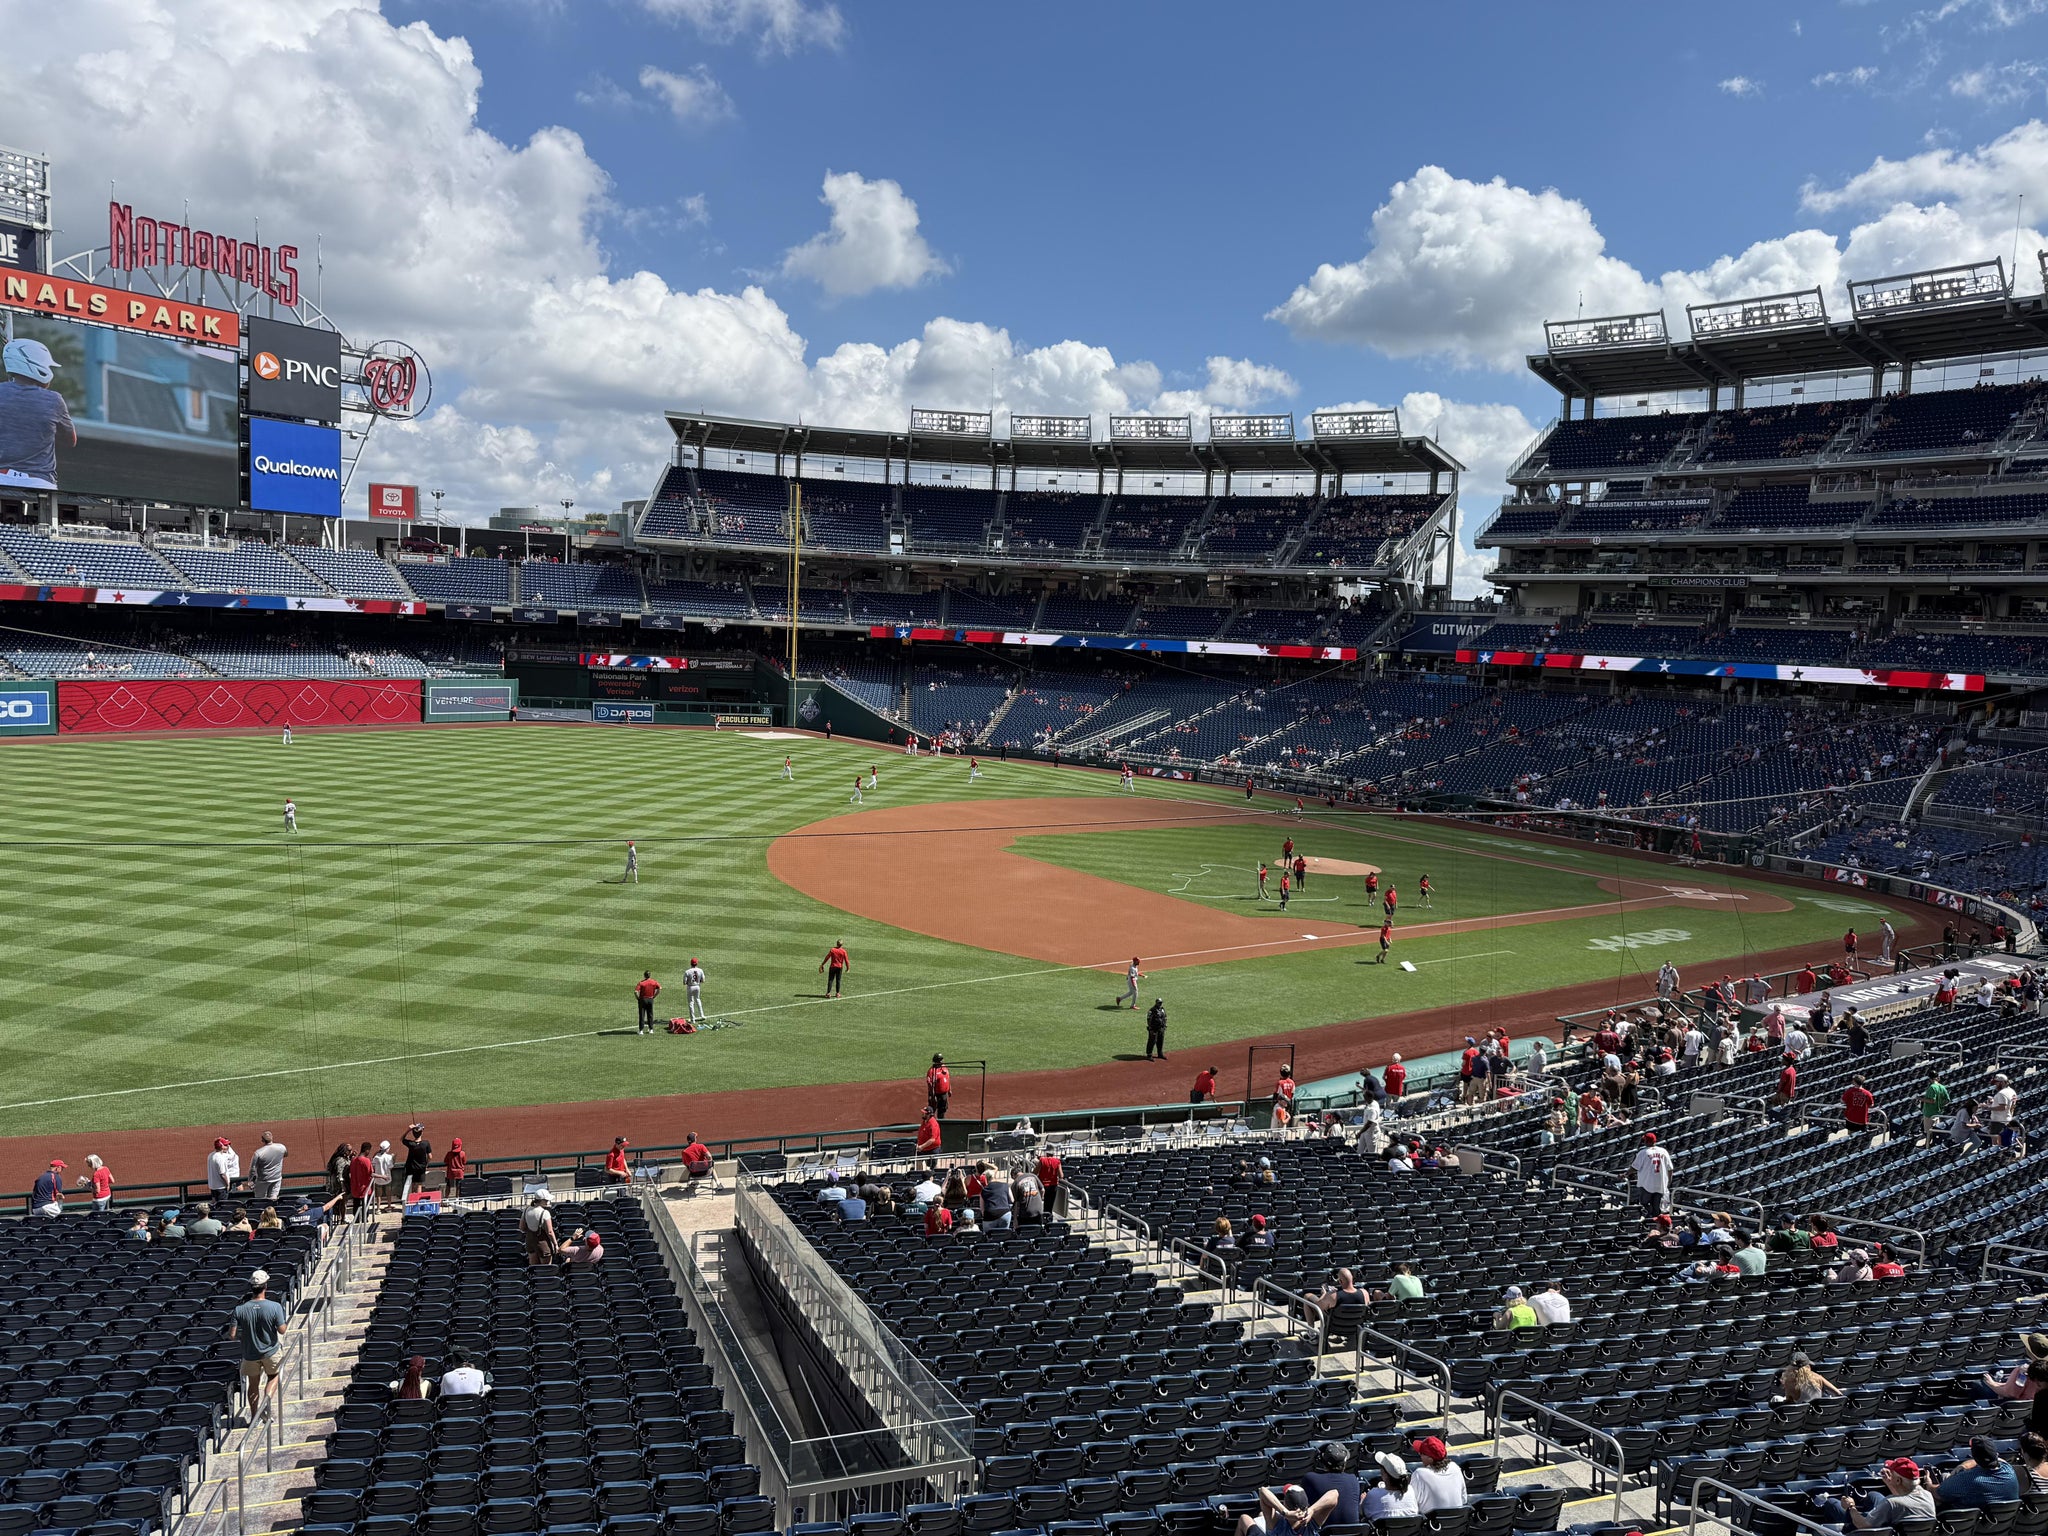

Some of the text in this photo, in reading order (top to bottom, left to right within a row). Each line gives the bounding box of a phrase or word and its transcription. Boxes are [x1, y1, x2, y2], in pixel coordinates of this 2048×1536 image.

[110, 201, 298, 306] NATIONALS
[6, 276, 221, 338] NALS PARK
[283, 359, 338, 388] PNC
[255, 456, 338, 480] Qualcomm
[378, 508, 407, 517] TOYOTA
[1671, 578, 1720, 586] CHAMPIONS
[1723, 578, 1746, 586] CLUB
[592, 672, 647, 681] Nationals Park
[598, 680, 642, 689] powered by
[668, 685, 699, 693] verizon
[606, 687, 634, 695] Verizon
[435, 696, 506, 705] VENTURE GLOBAL
[610, 709, 652, 718] DABOS
[749, 716, 769, 725] FENCE
